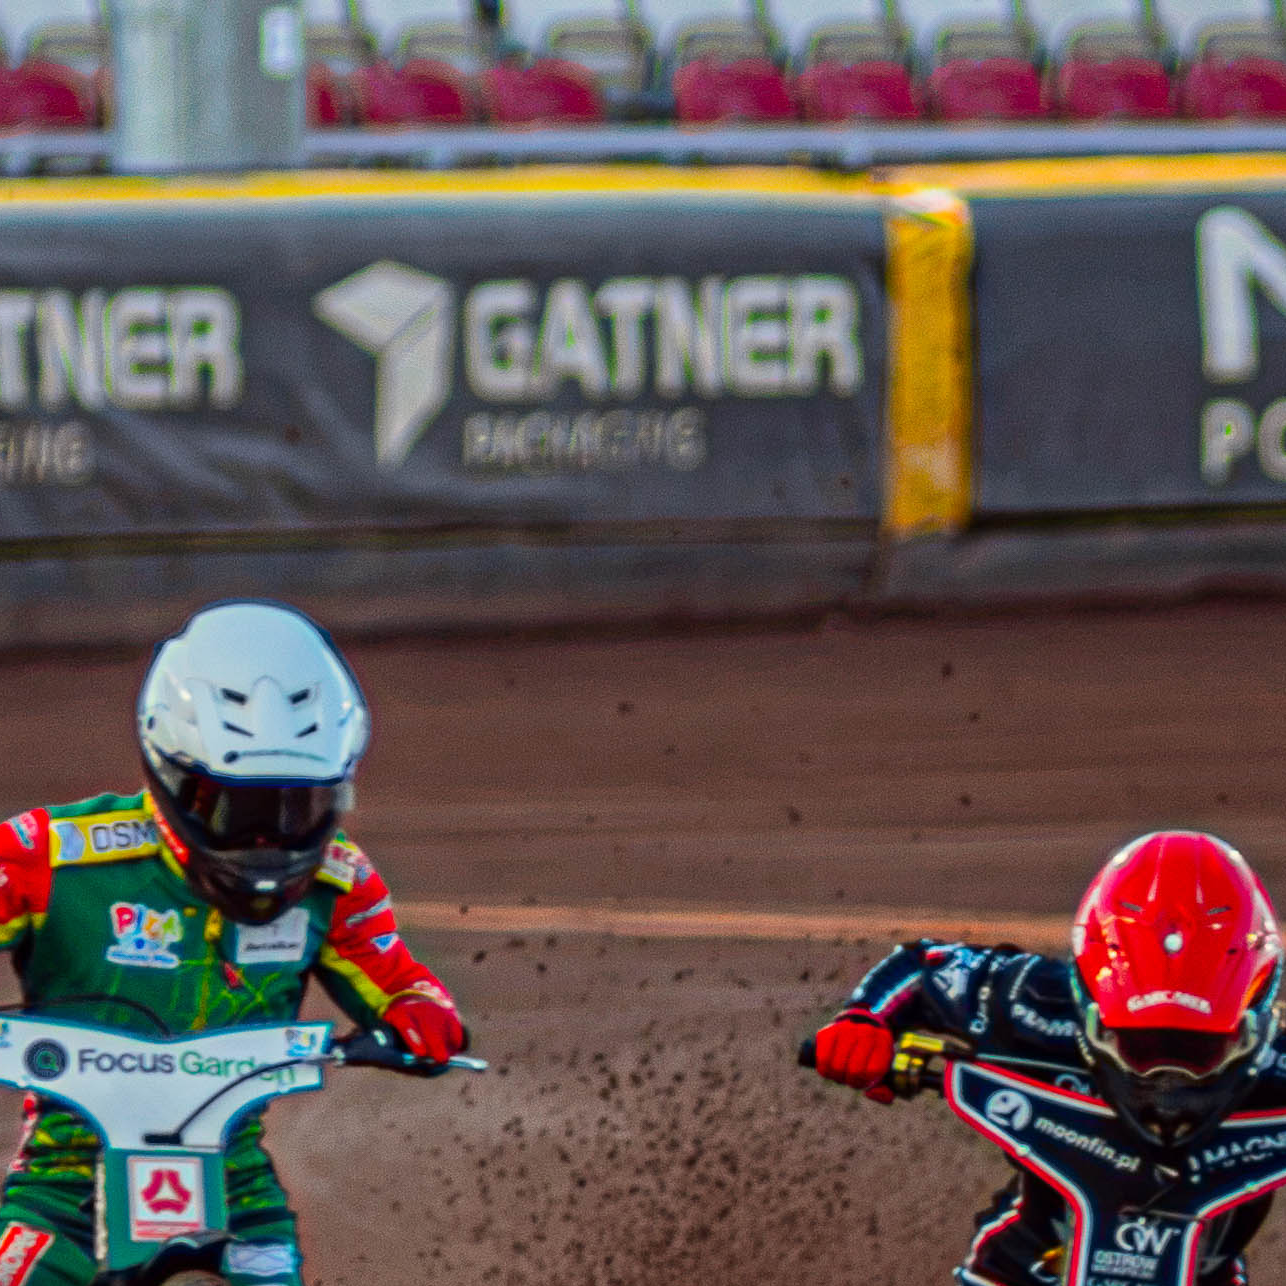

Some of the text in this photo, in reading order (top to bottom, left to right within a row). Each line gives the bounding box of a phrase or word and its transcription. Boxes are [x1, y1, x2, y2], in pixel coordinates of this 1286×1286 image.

[464, 273, 864, 401] GATNER
[76, 1047, 178, 1075] Focus
[1034, 1117, 1141, 1173] moonfin.pl
